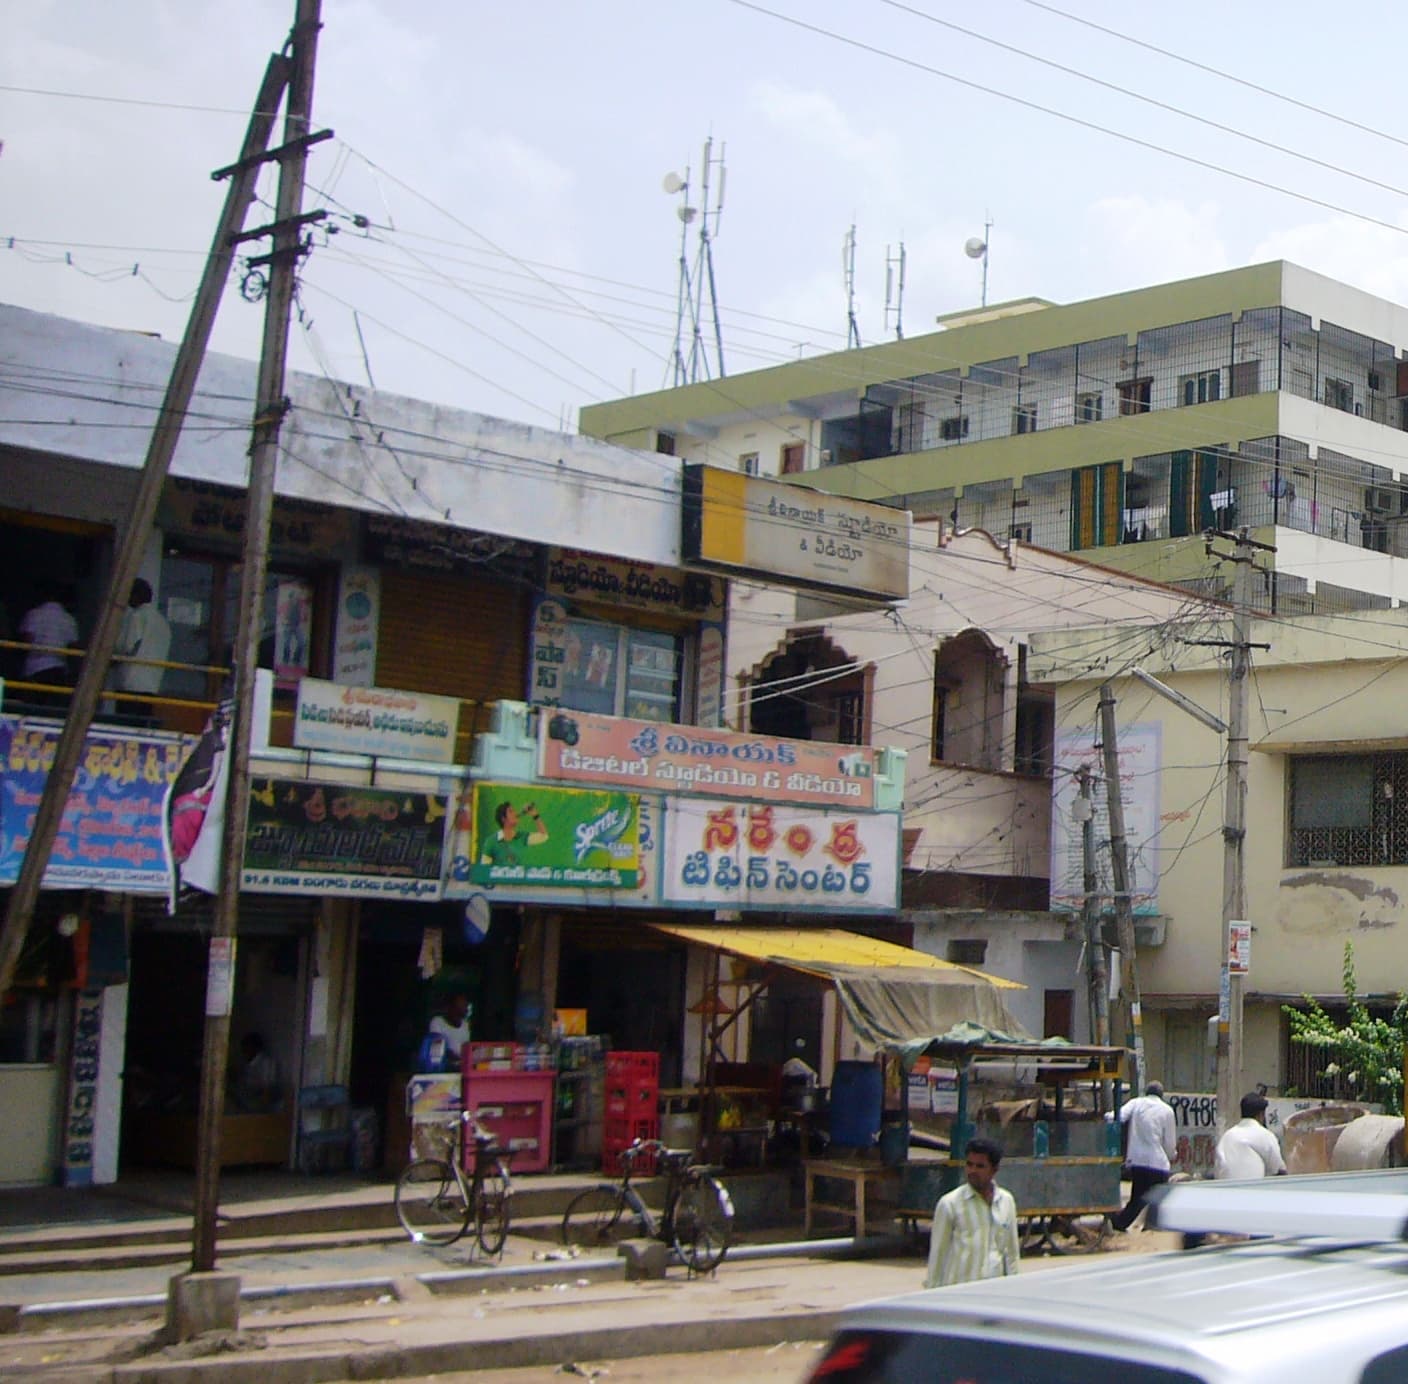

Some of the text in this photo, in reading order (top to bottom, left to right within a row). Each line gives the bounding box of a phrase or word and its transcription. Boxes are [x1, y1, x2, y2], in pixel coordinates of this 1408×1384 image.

[838, 511, 898, 540] స్టూడియో
[815, 535, 863, 560] వీడియో
[631, 727, 798, 766] శ్రీ వినాయక్
[656, 762, 757, 790] స్టూడియో
[762, 772, 780, 789] &
[787, 774, 861, 797] వీడియో
[703, 805, 867, 868] నరేంద్ర
[682, 850, 872, 894] టిఫిన్ సెంటర్
